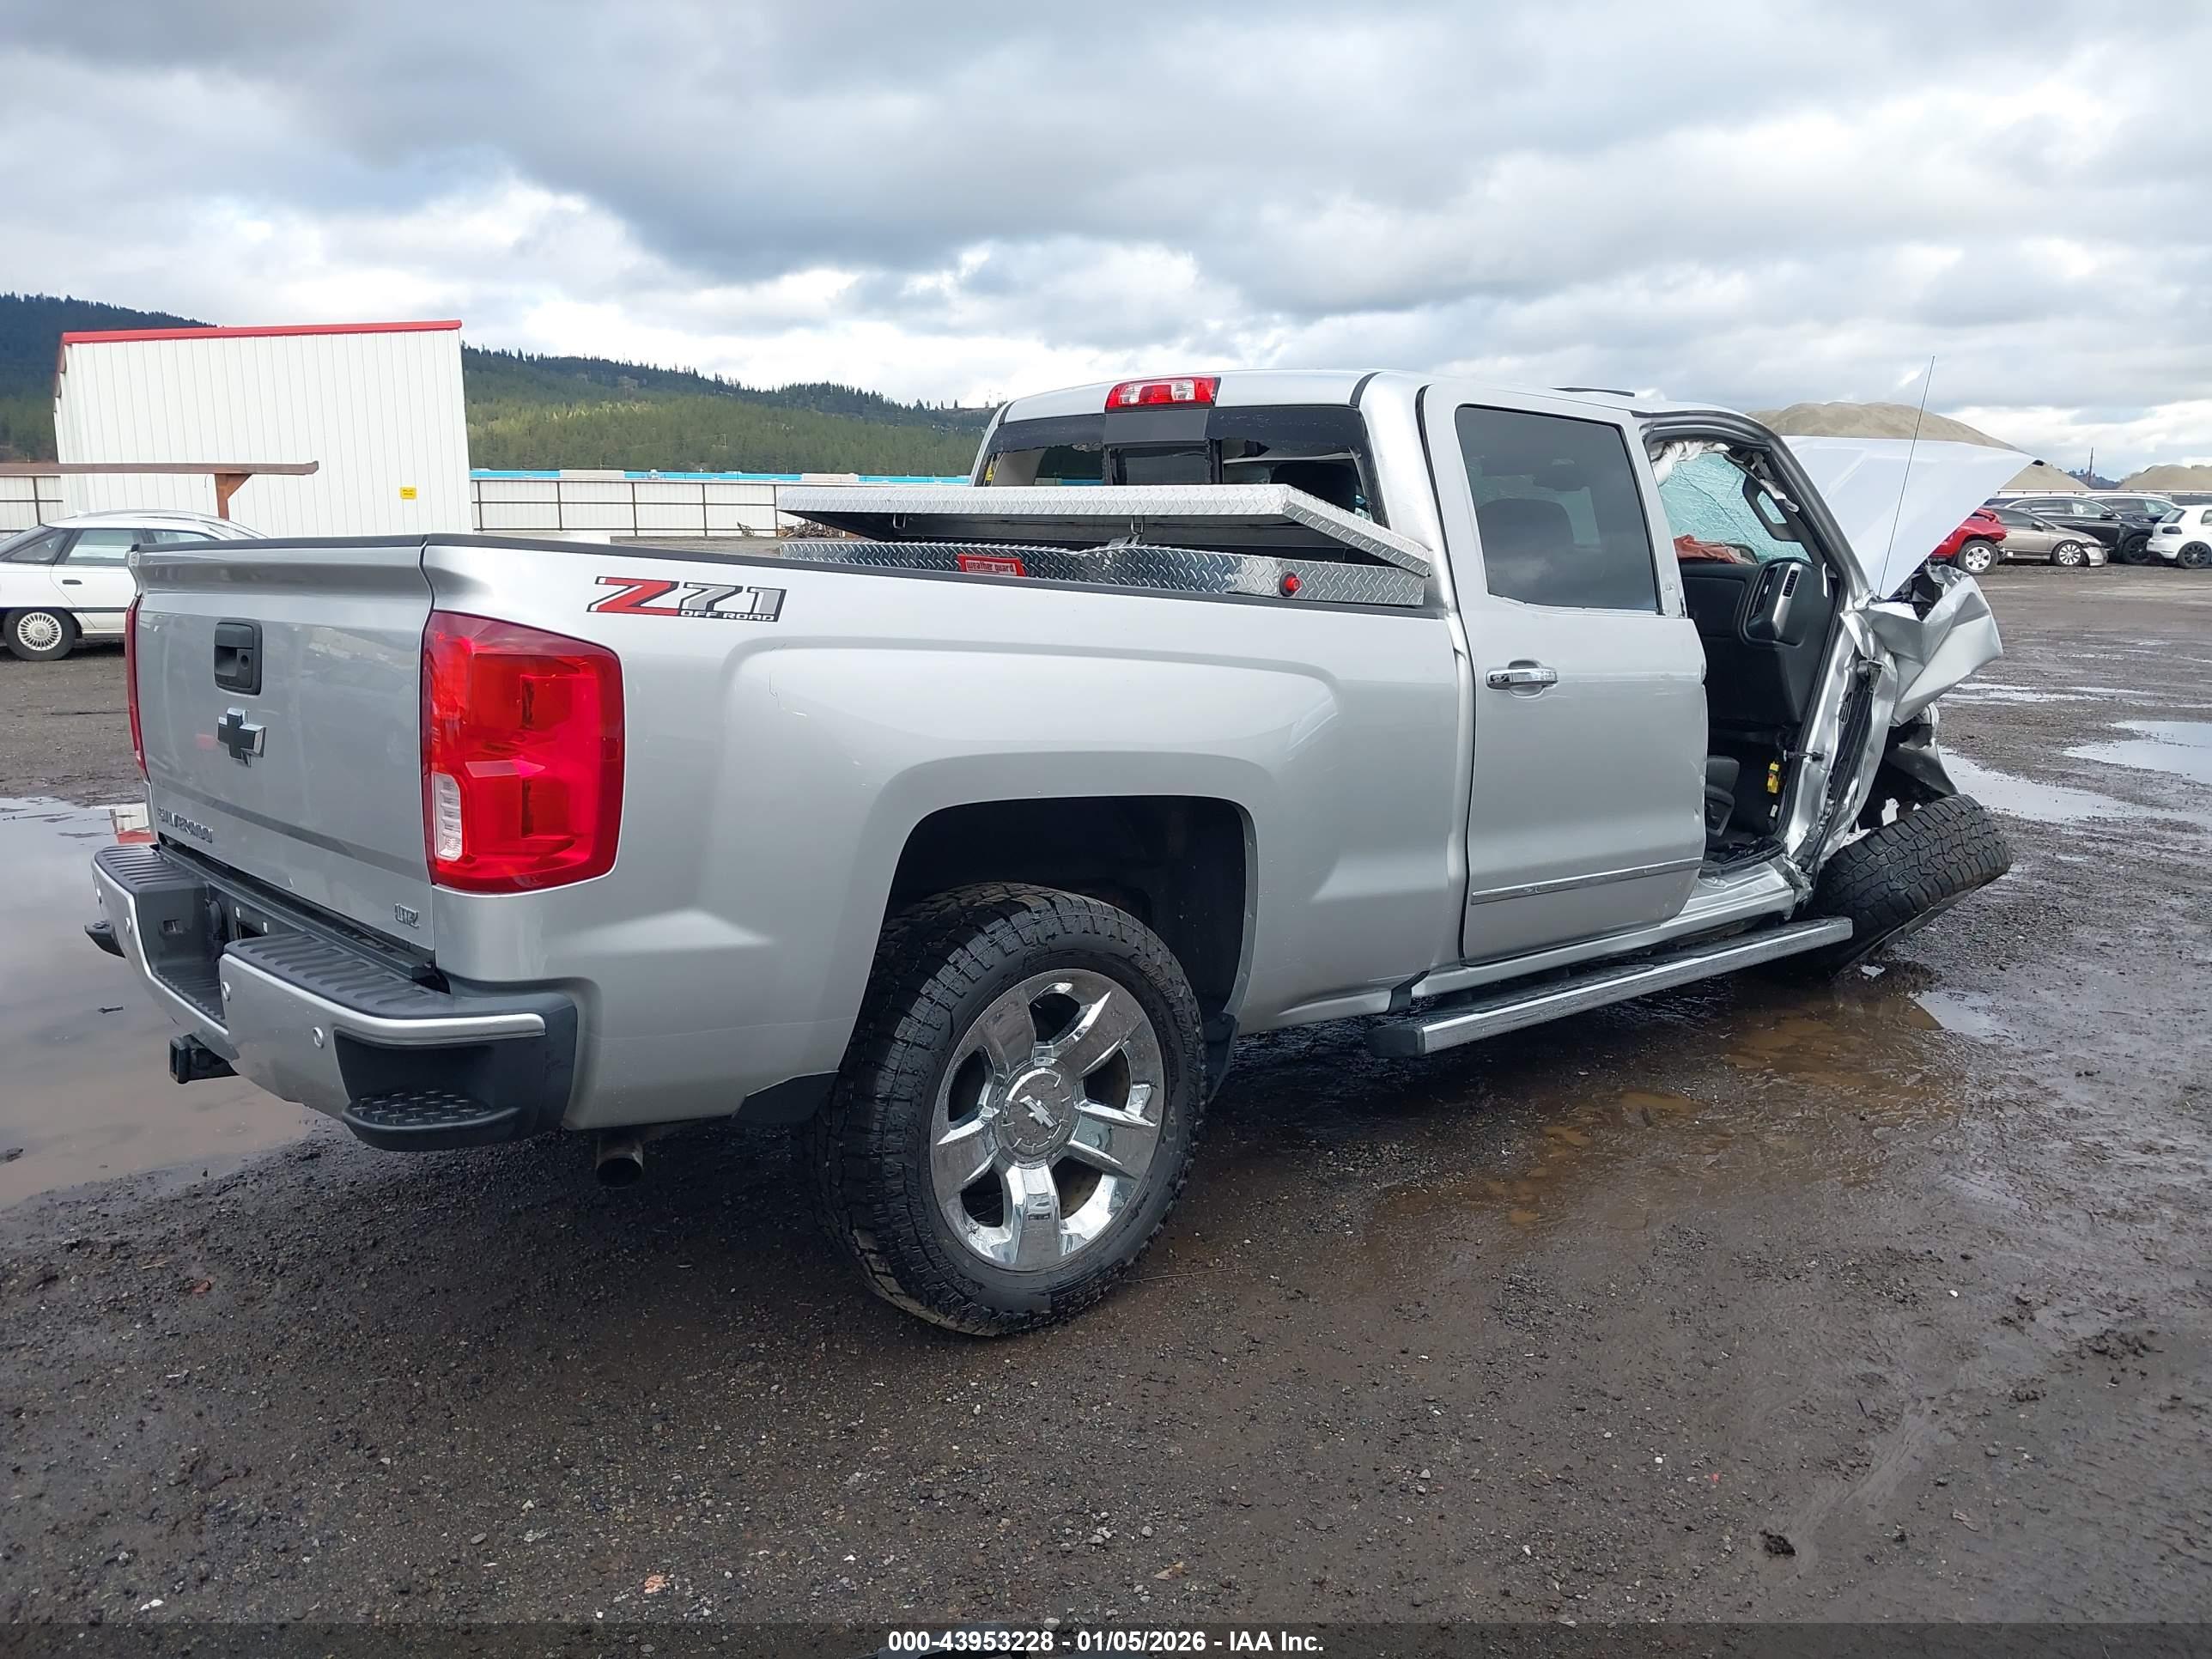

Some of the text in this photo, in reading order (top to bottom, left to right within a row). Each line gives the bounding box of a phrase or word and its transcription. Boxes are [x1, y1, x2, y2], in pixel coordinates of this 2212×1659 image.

[586, 576, 787, 622] Z71
[680, 610, 775, 622] OFF ROAD
